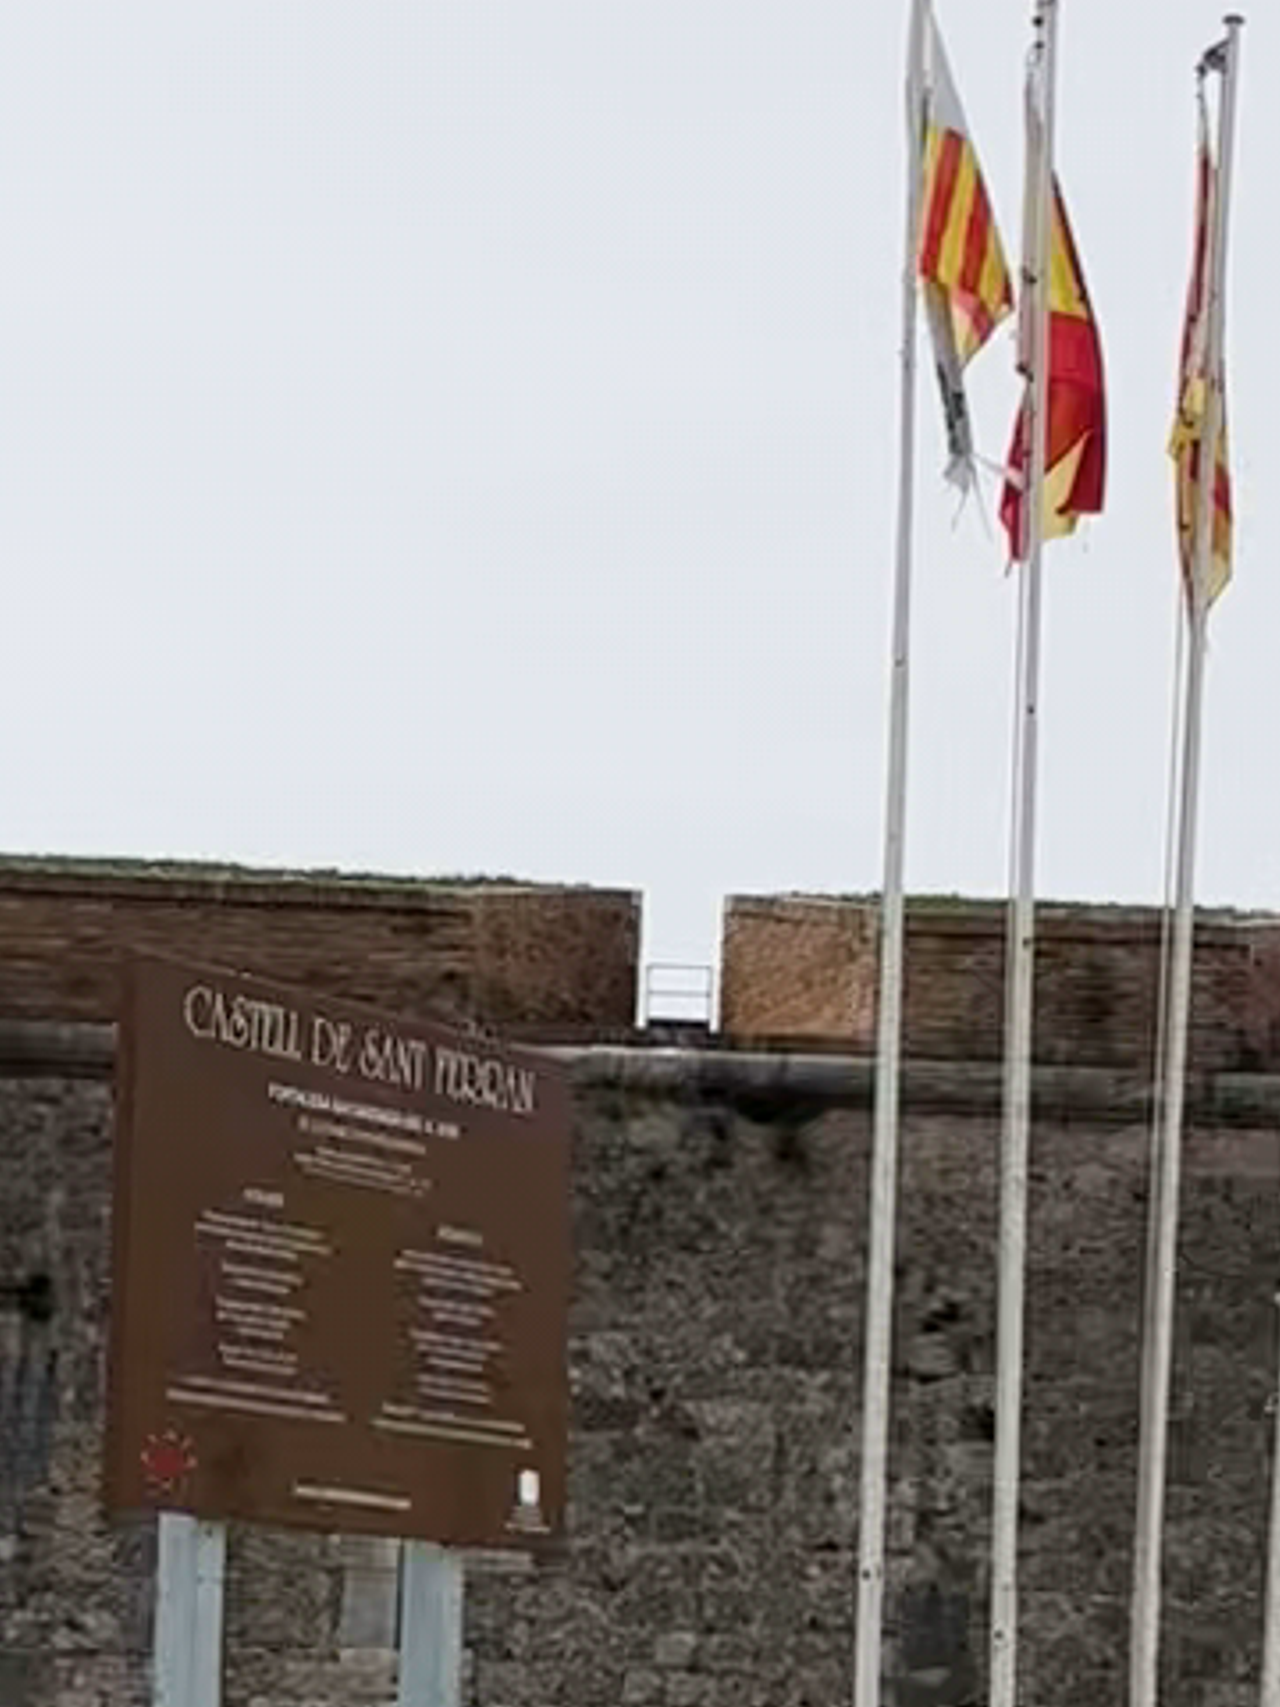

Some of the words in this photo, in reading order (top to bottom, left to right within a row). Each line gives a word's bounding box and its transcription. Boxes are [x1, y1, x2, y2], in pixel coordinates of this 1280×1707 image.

[183, 985, 302, 1063] CASTELL
[312, 1016, 352, 1073] DE
[359, 1027, 427, 1089] SANT
